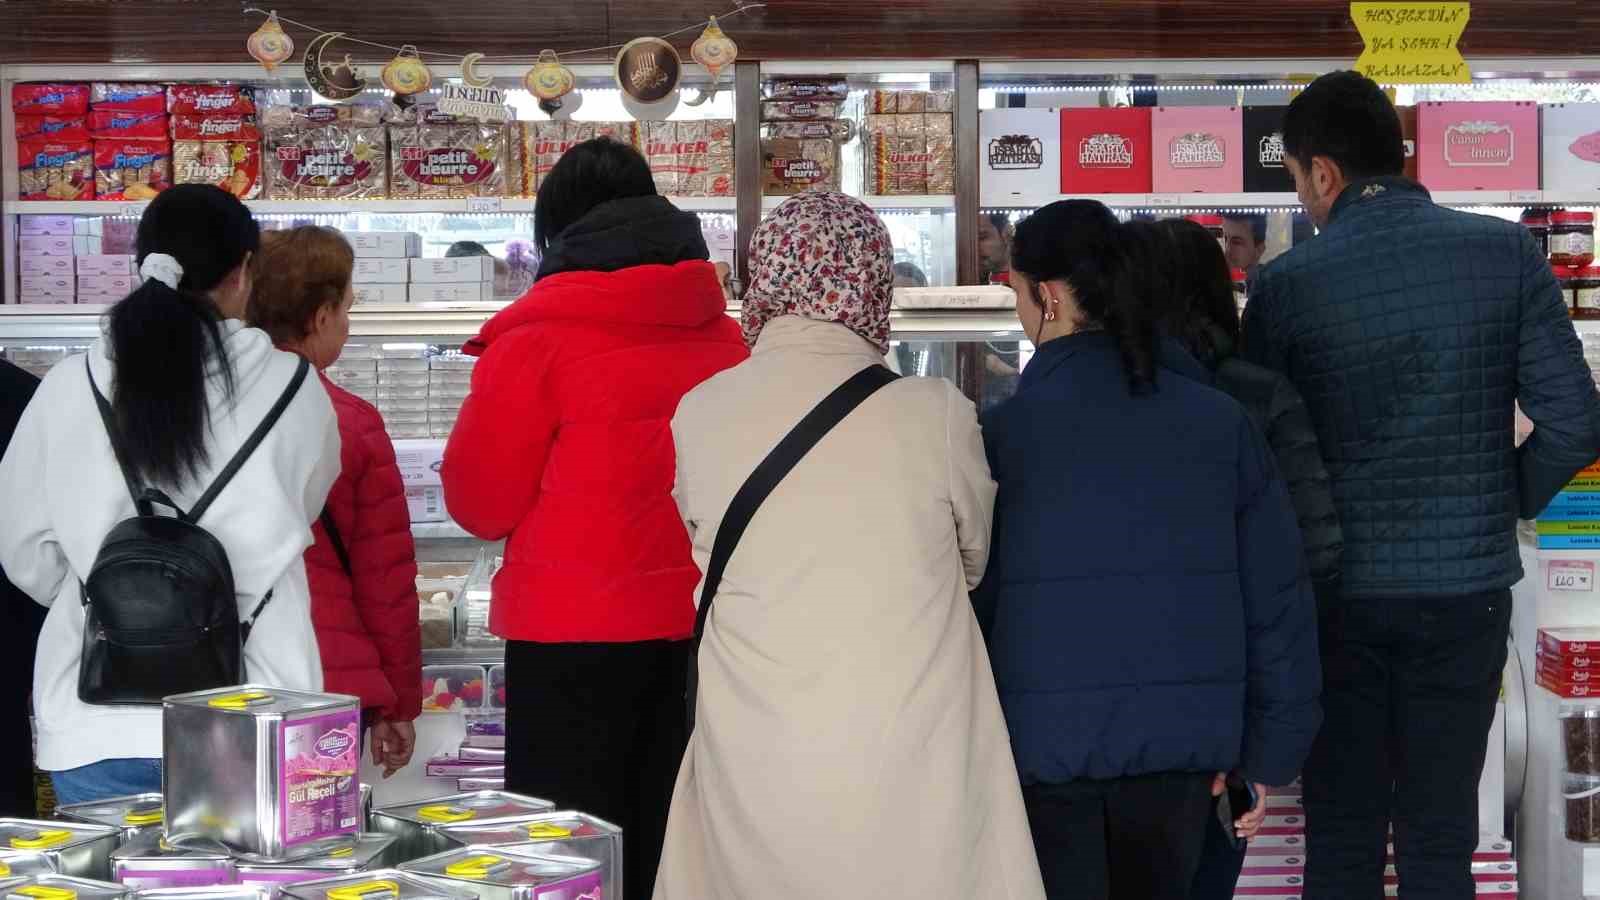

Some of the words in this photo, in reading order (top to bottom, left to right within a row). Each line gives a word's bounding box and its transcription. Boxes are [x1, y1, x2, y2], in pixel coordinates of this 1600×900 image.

[1372, 37, 1394, 53] YA
[1365, 62, 1464, 77] RAMAZAN
[535, 137, 577, 154] ÜLK
[646, 138, 709, 154] ÜLKER
[36, 151, 76, 167] Finger
[115, 152, 155, 168] Finger
[305, 152, 346, 164] petit
[428, 151, 469, 164] petit
[183, 159, 236, 179] finger
[297, 162, 355, 176] beurre
[420, 162, 477, 176] beurre
[789, 160, 815, 171] petit
[784, 169, 820, 178] beurre
[288, 790, 305, 804] Gül
[307, 783, 335, 801] Reçeli
